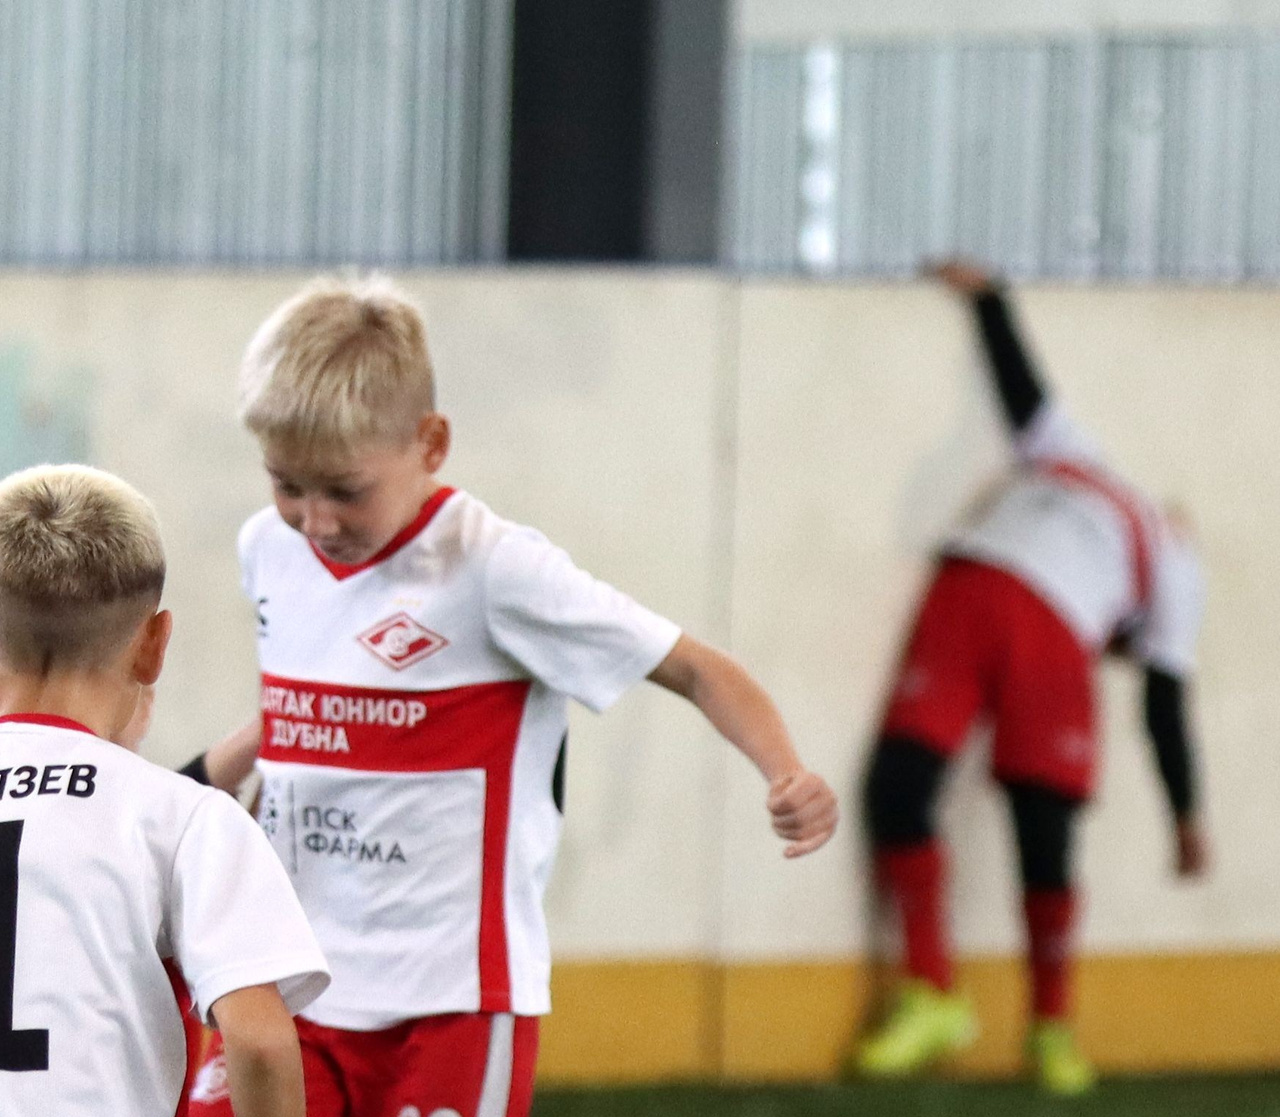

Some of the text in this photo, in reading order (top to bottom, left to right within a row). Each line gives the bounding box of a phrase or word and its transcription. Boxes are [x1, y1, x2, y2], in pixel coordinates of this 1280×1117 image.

[322, 694, 427, 728] ЮНИОР
[271, 717, 351, 753] ДУБНА
[303, 805, 357, 831] ПСК
[304, 832, 406, 863] ФАРМА
